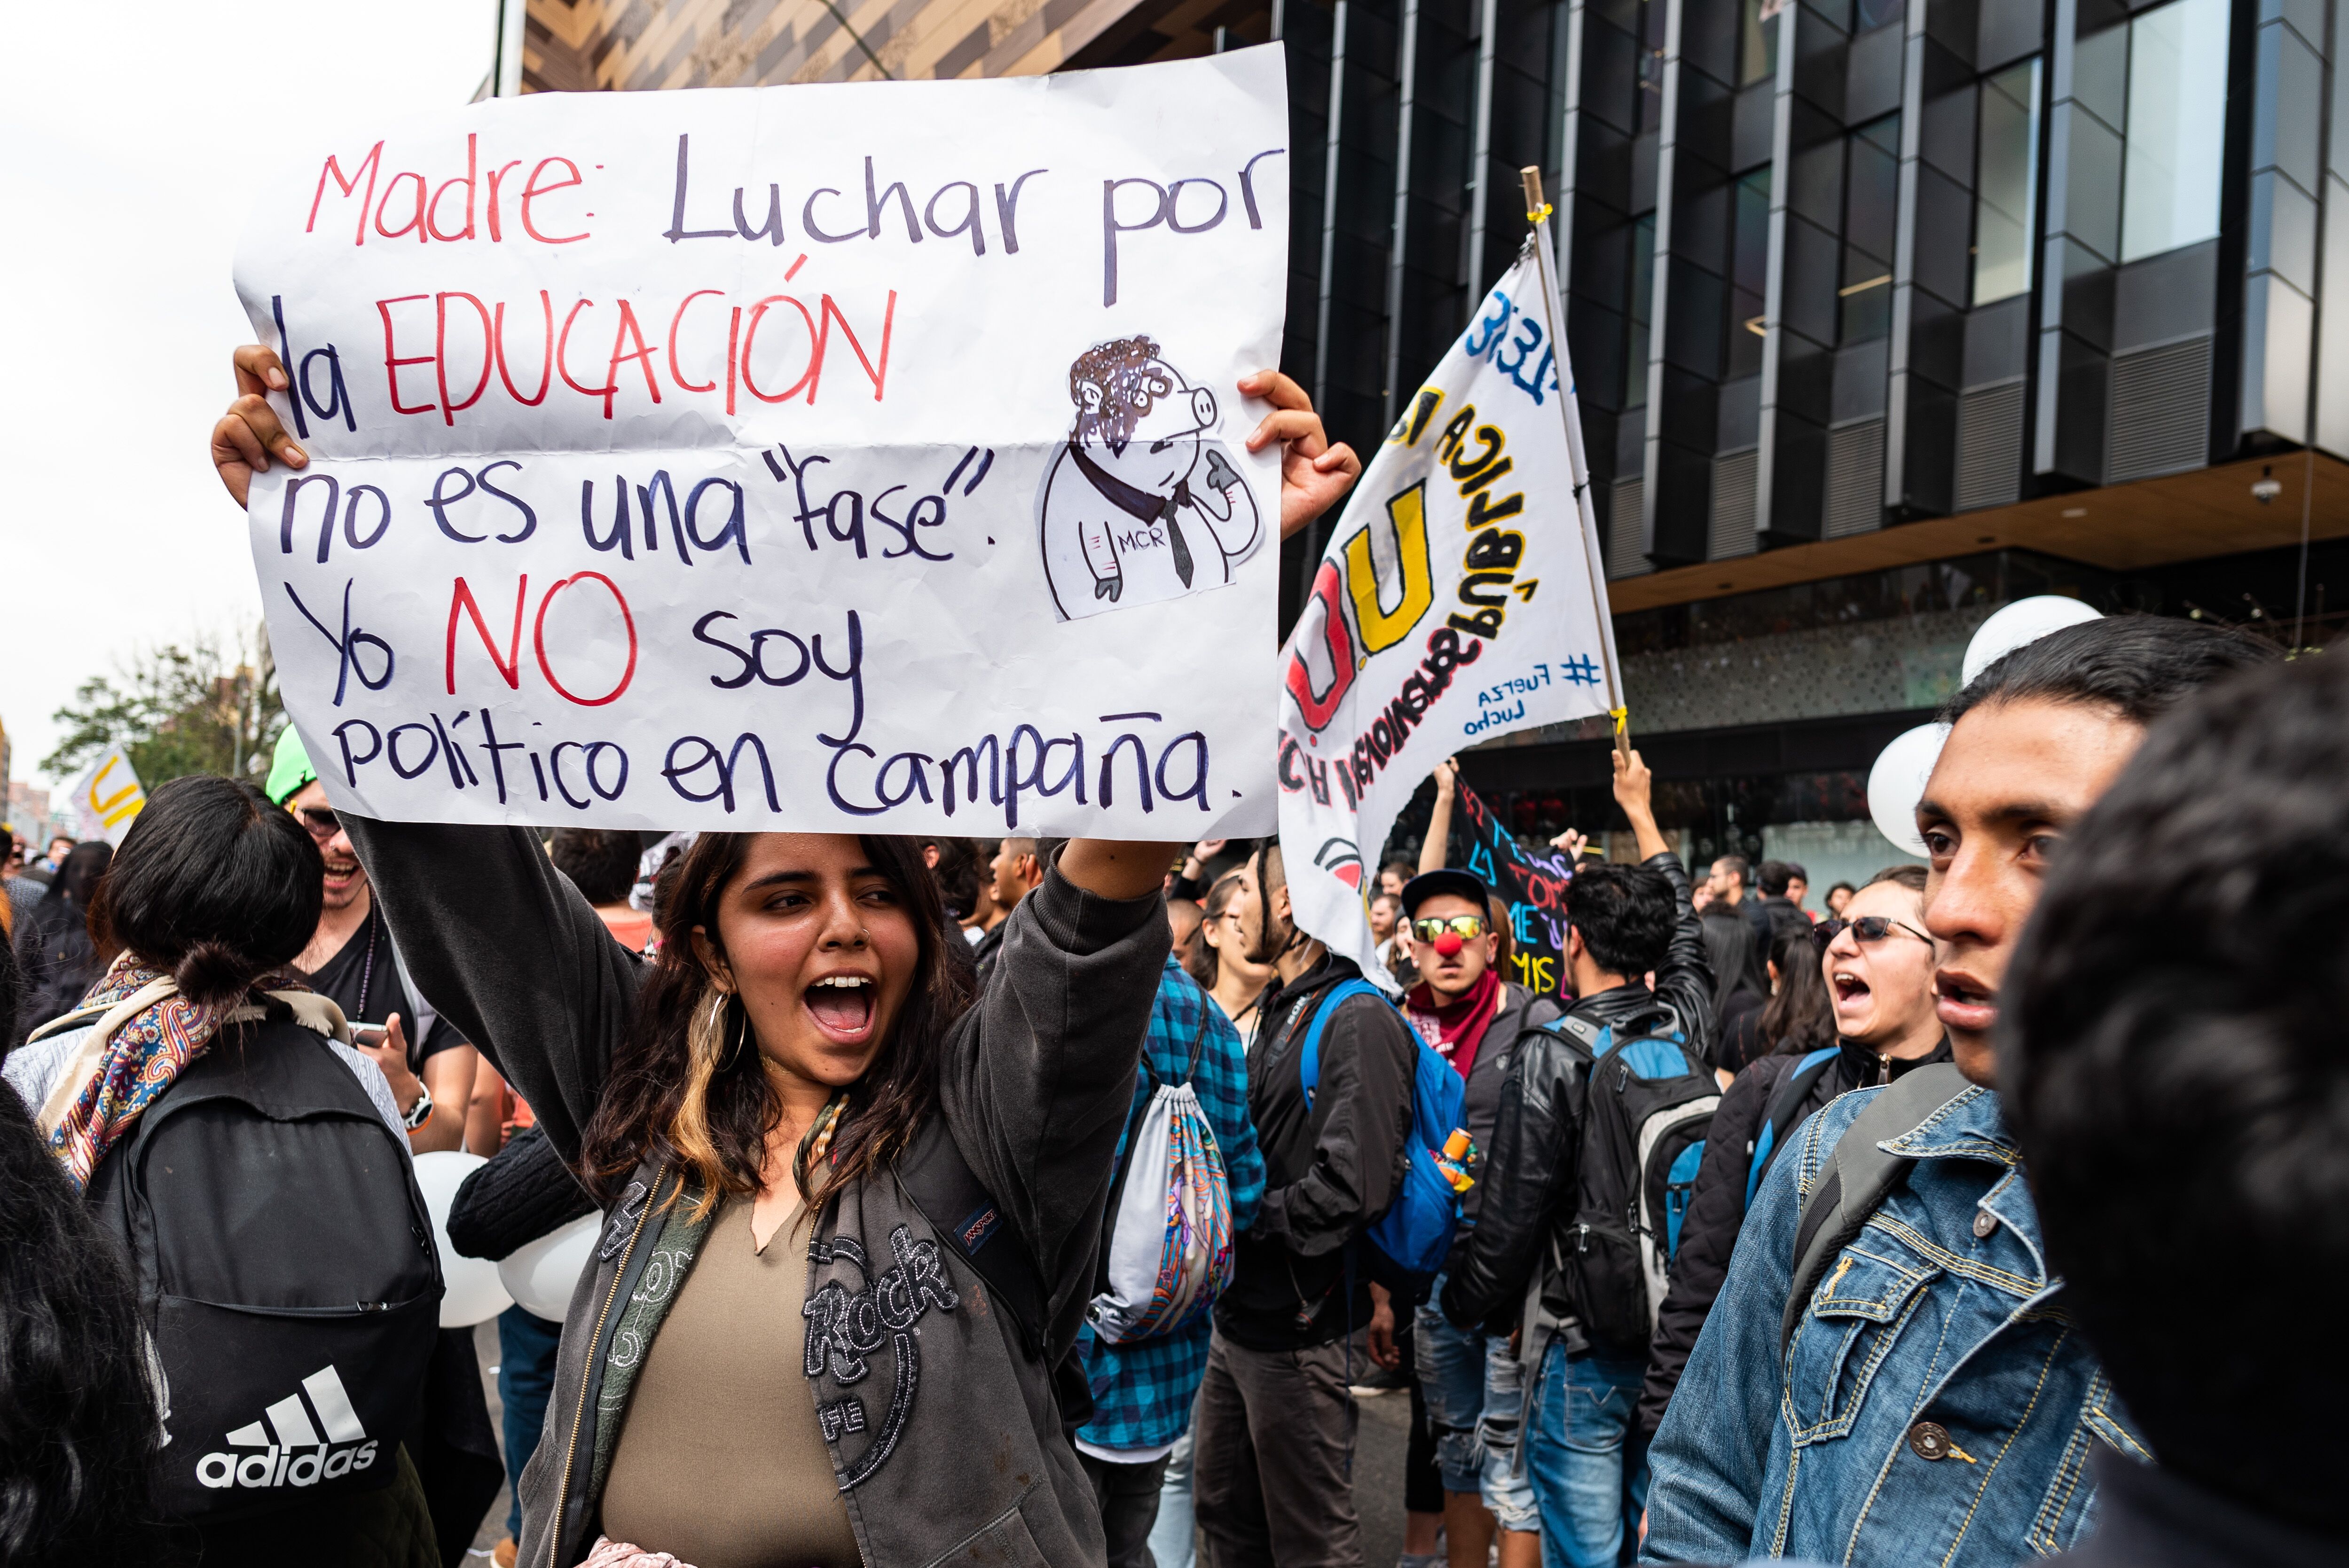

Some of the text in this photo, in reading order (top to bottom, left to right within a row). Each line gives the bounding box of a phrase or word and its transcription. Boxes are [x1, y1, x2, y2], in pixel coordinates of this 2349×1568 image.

[306, 133, 1285, 308] Madre: Luchar por
[272, 253, 897, 440] la EDUCACIÓN
[281, 474, 391, 564] no
[424, 460, 537, 543] es
[581, 470, 752, 566] una
[1117, 528, 1166, 556] MCR
[284, 571, 863, 747] Yo NO soy
[331, 707, 1242, 830] político en campaña.
[963, 1208, 996, 1246] JANSPORT
[801, 1223, 959, 1383] Rock
[196, 1440, 378, 1488] adidas
